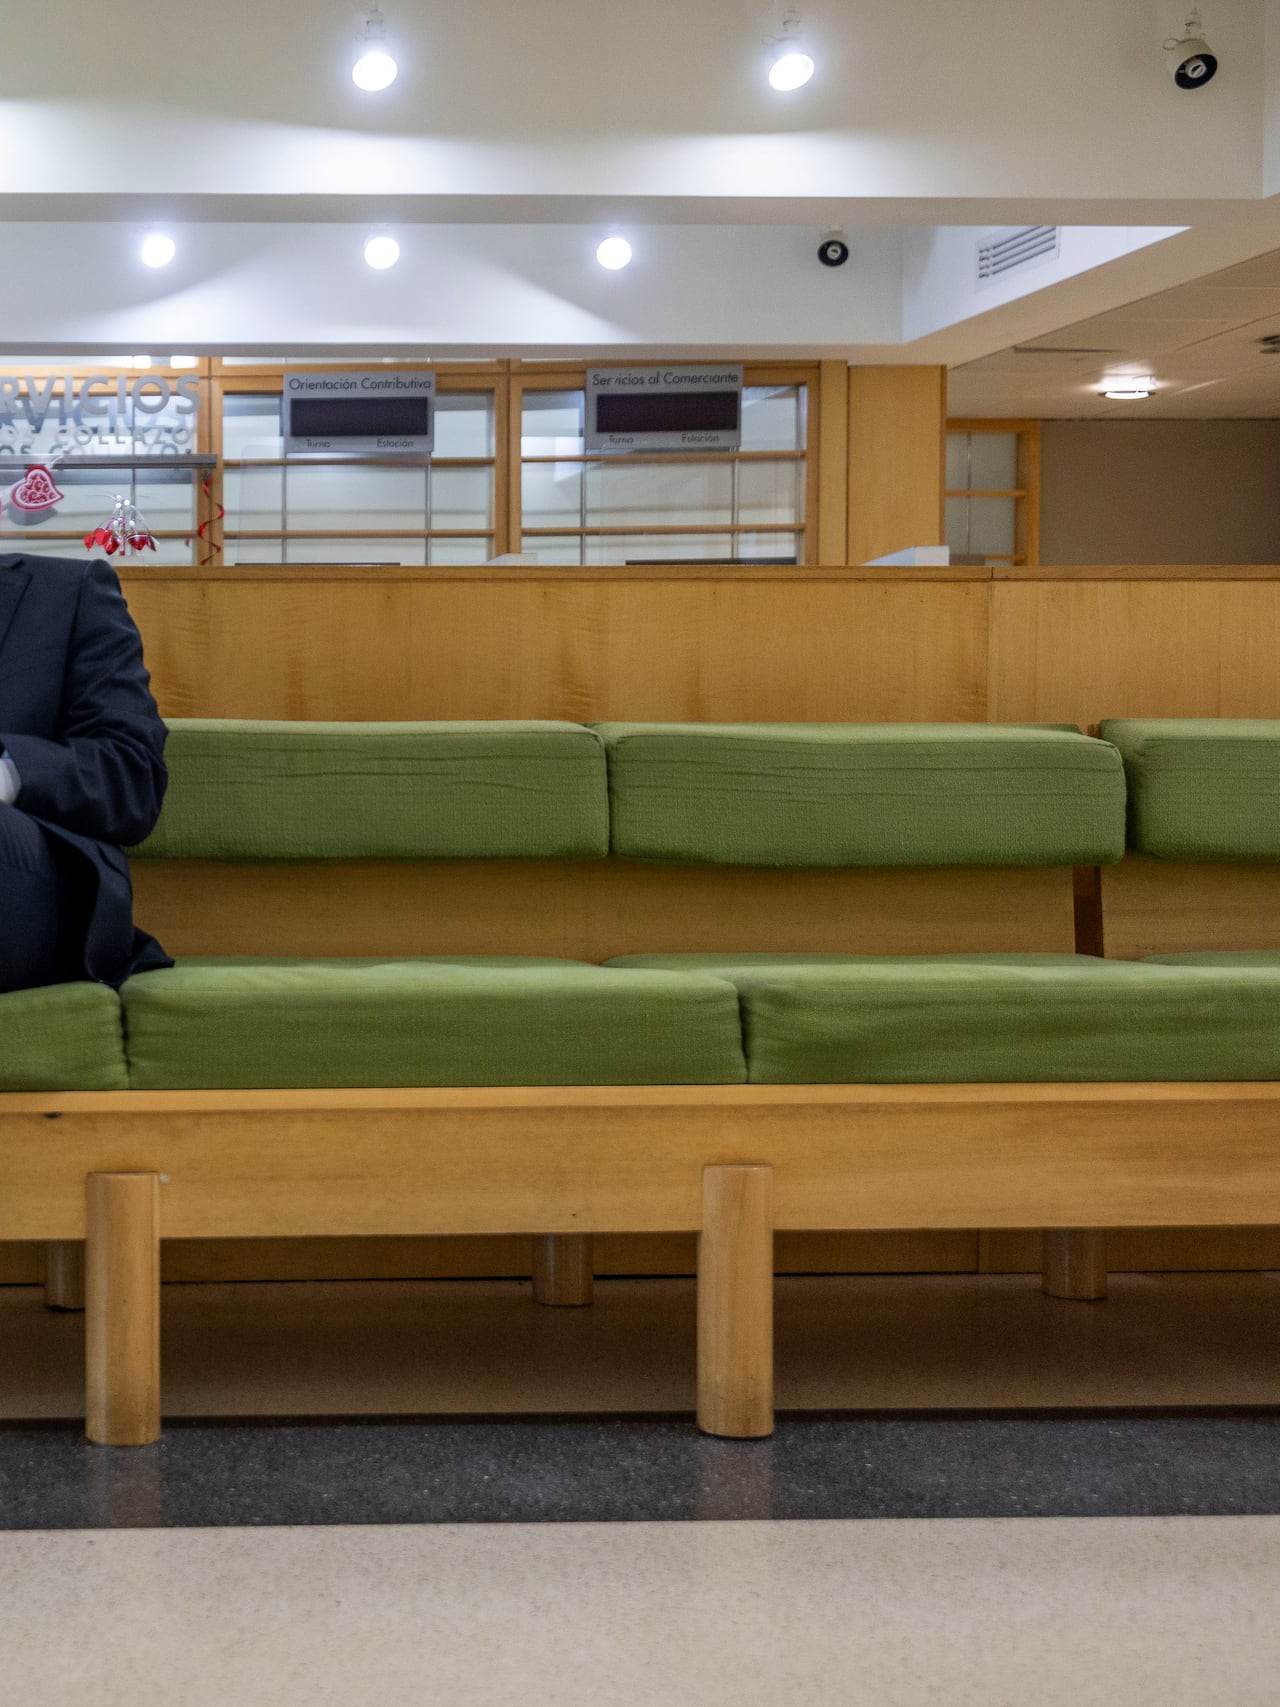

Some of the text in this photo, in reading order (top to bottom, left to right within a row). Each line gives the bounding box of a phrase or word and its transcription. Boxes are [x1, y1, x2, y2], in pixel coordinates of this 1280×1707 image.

[289, 375, 431, 391] Orientación Contributiva
[648, 371, 660, 385] al
[663, 371, 739, 385] Comerciante
[55, 424, 193, 446] COLLAZO
[609, 434, 634, 444] Turno
[306, 438, 414, 449] Turno Estación
